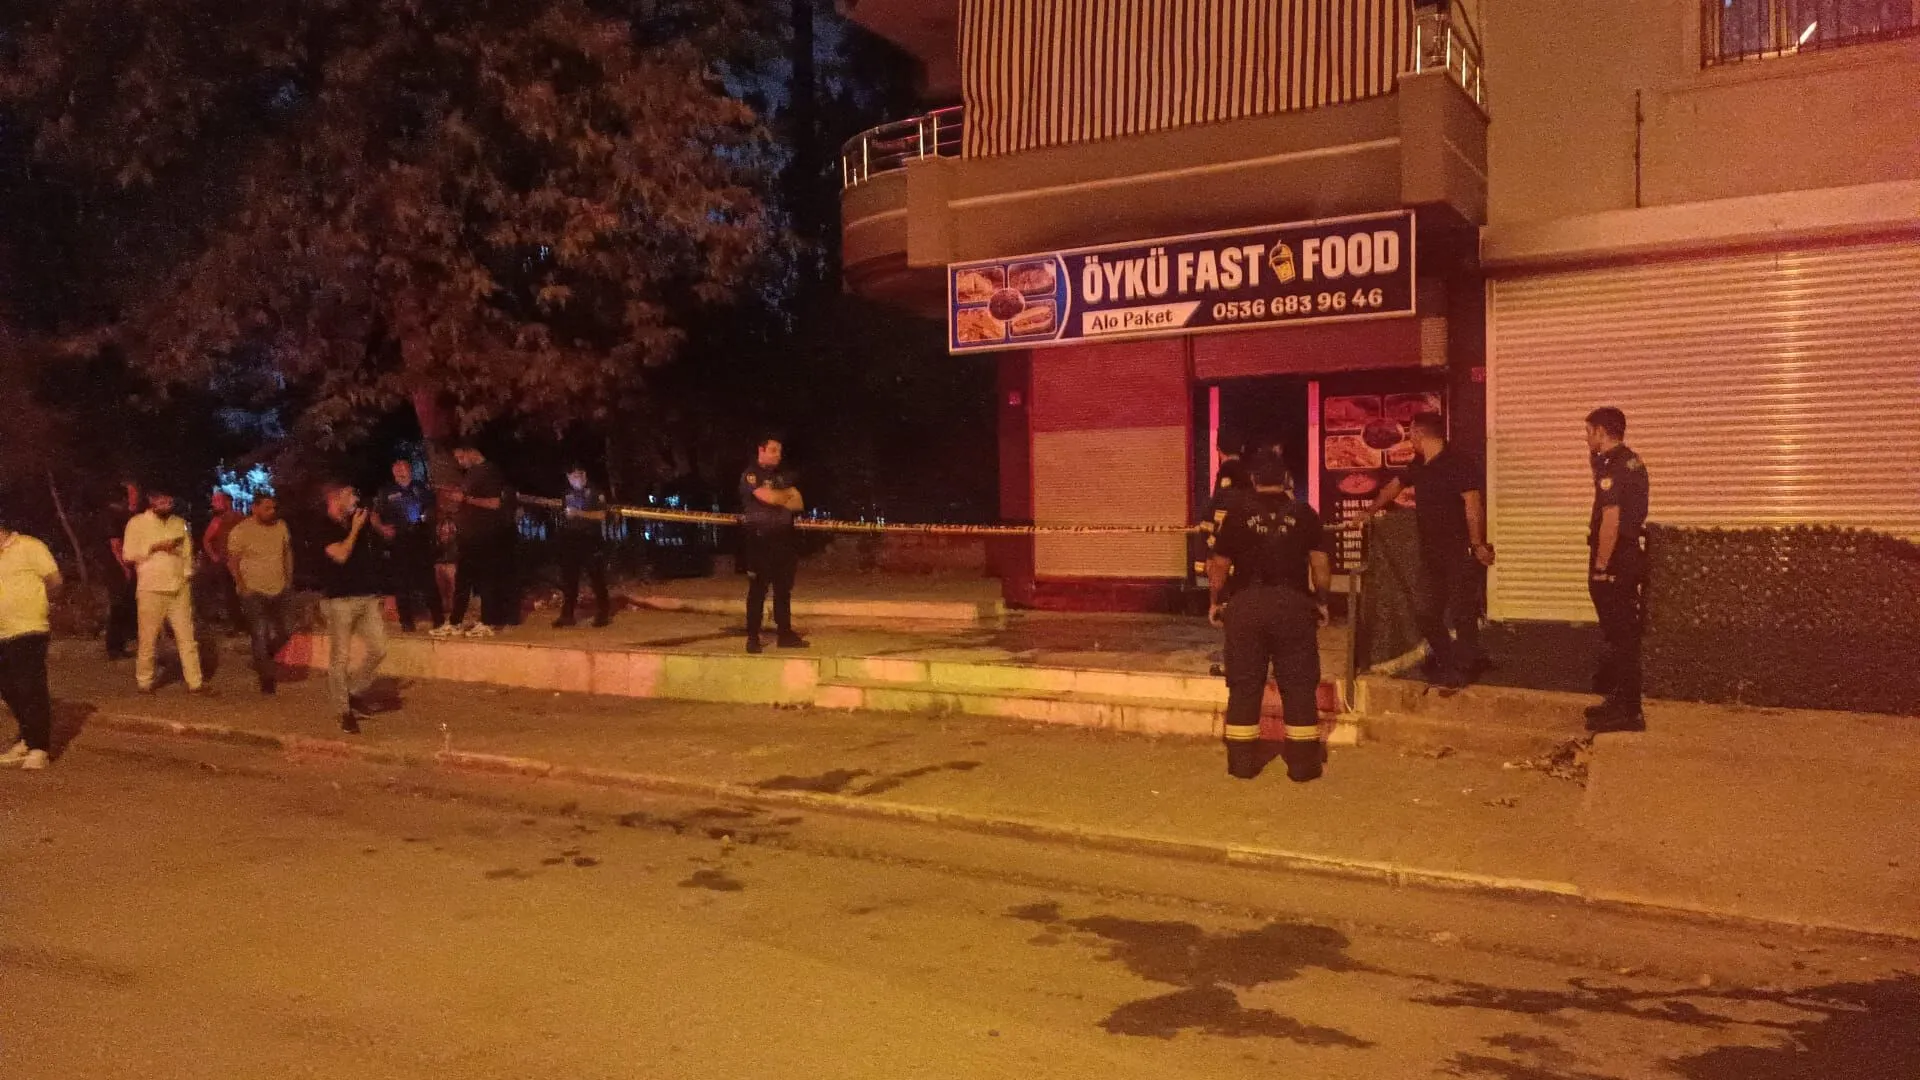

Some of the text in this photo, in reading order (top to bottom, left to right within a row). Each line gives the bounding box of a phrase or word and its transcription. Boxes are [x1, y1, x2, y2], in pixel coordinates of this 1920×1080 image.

[1083, 230, 1400, 303] ÖYKÜ FAST FOOD
[1091, 309, 1173, 331] Alo Paket
[1213, 287, 1383, 320] 0536 683 96 46
